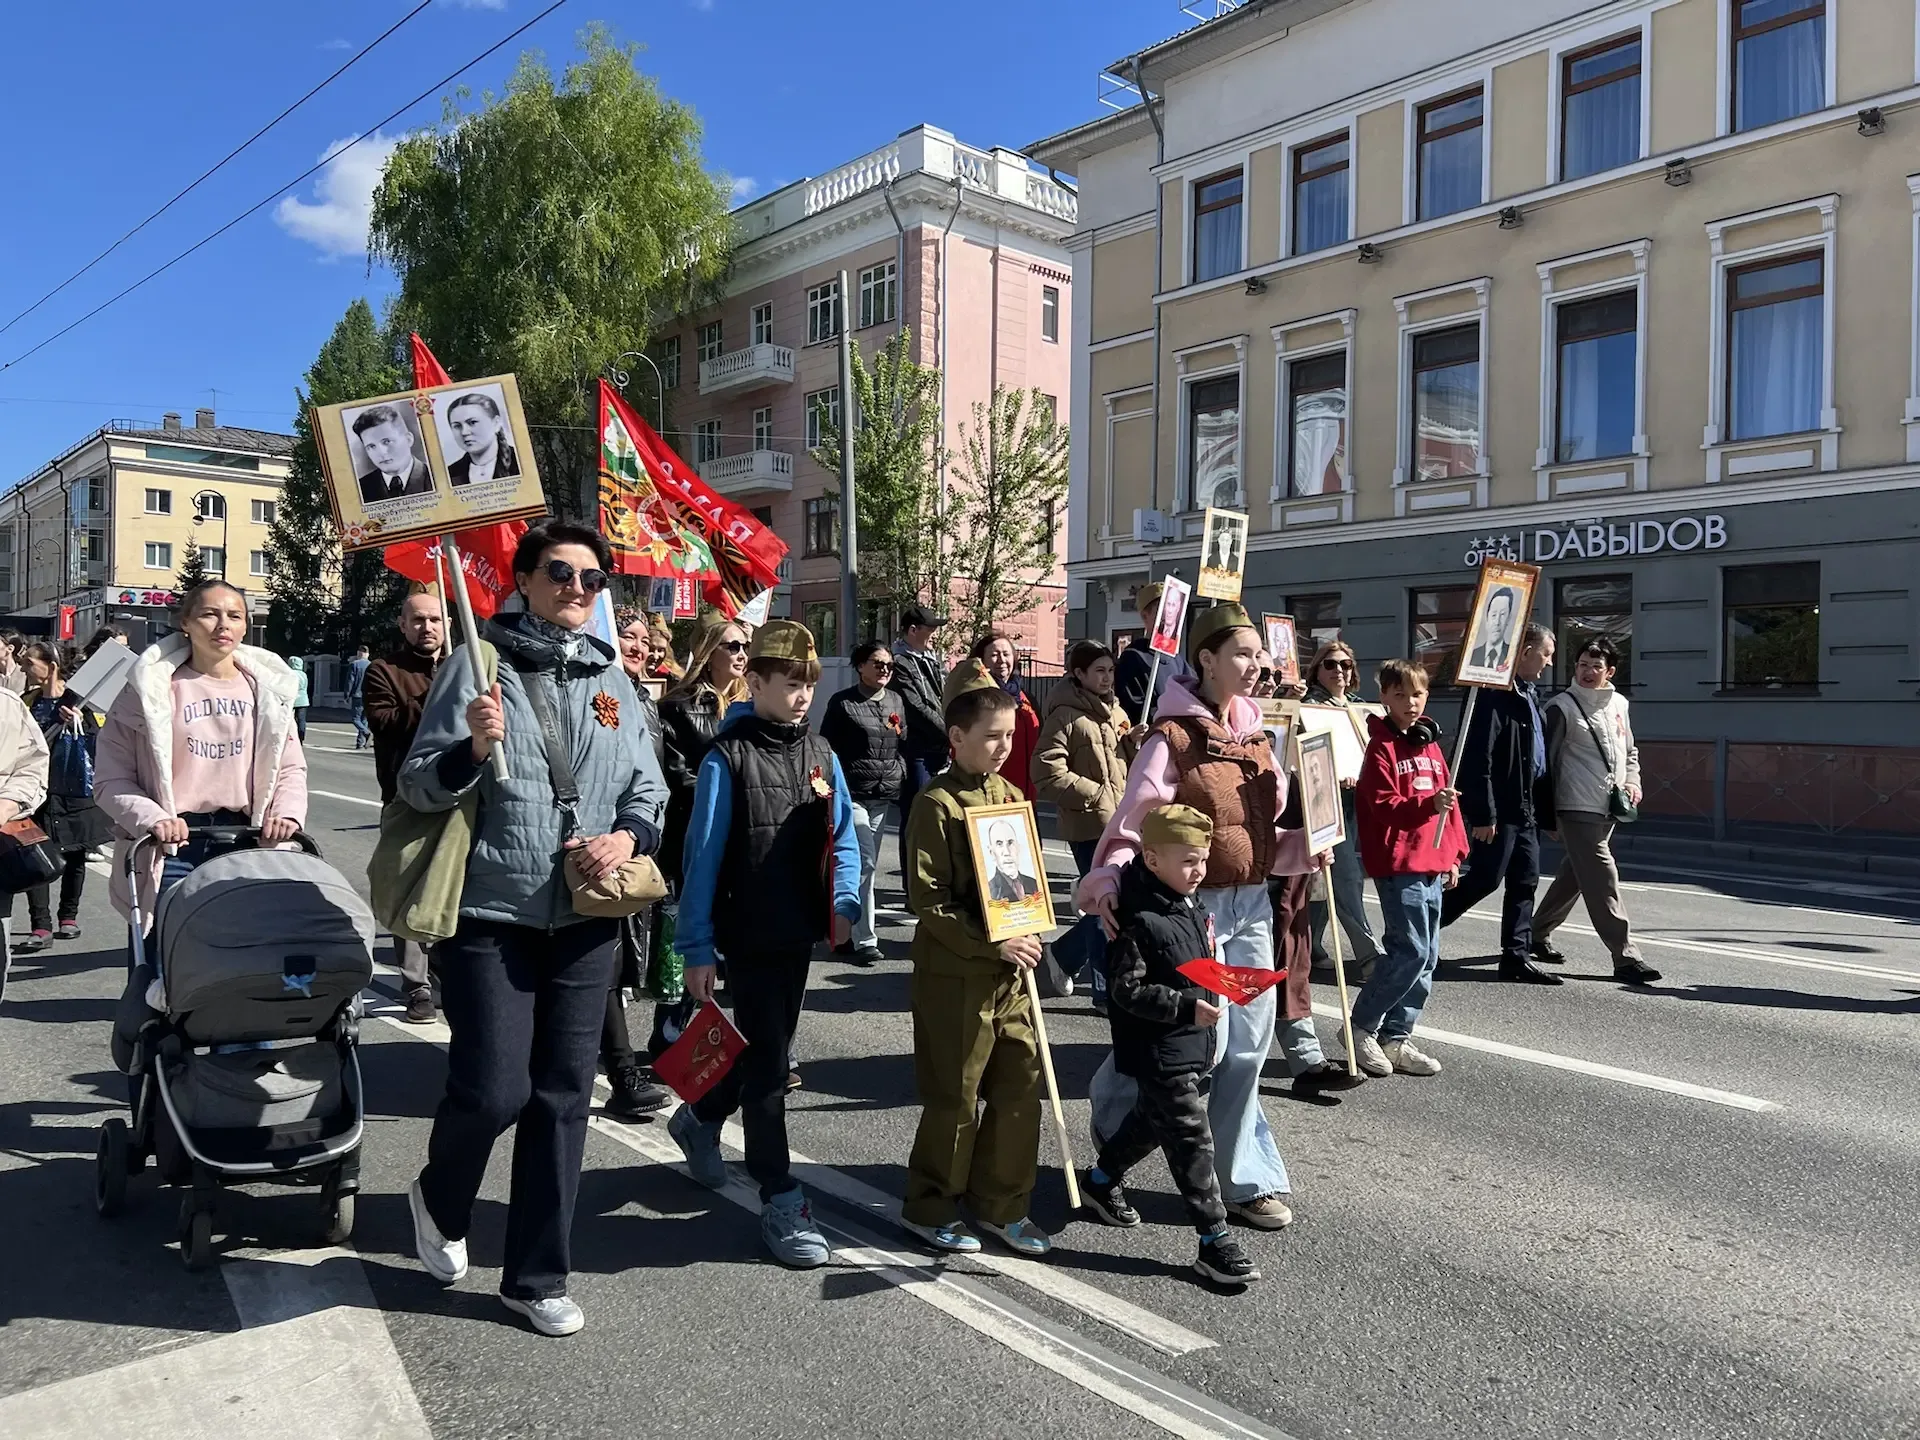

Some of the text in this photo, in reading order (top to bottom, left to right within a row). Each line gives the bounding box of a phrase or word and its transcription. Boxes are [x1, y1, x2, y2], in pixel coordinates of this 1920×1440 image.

[453, 482, 494, 497] Ахметова
[360, 492, 443, 514] Шагабеев Шагавали
[1464, 547, 1518, 567] ОТЕЛЬ
[184, 697, 253, 723] OLD NAV
[187, 736, 245, 759] SINCE 19
